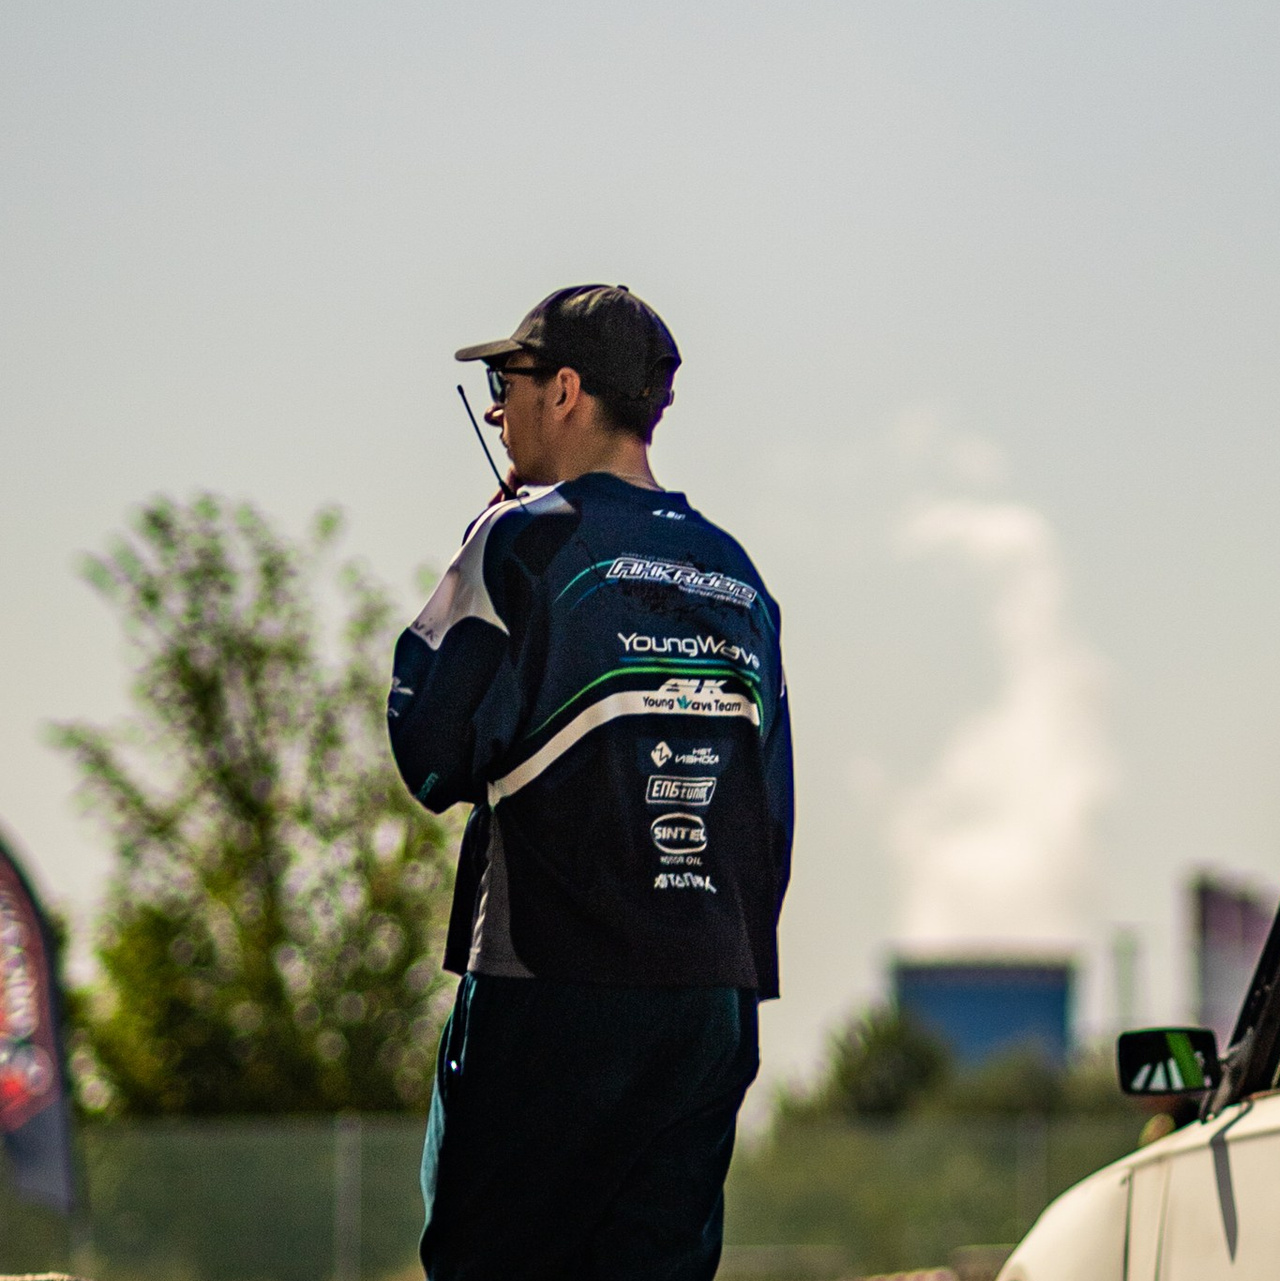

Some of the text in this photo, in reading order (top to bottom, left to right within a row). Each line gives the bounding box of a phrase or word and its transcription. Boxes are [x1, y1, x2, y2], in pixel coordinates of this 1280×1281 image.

[617, 632, 760, 670] YoungWave
[643, 696, 674, 710] Young
[713, 699, 741, 712] Team
